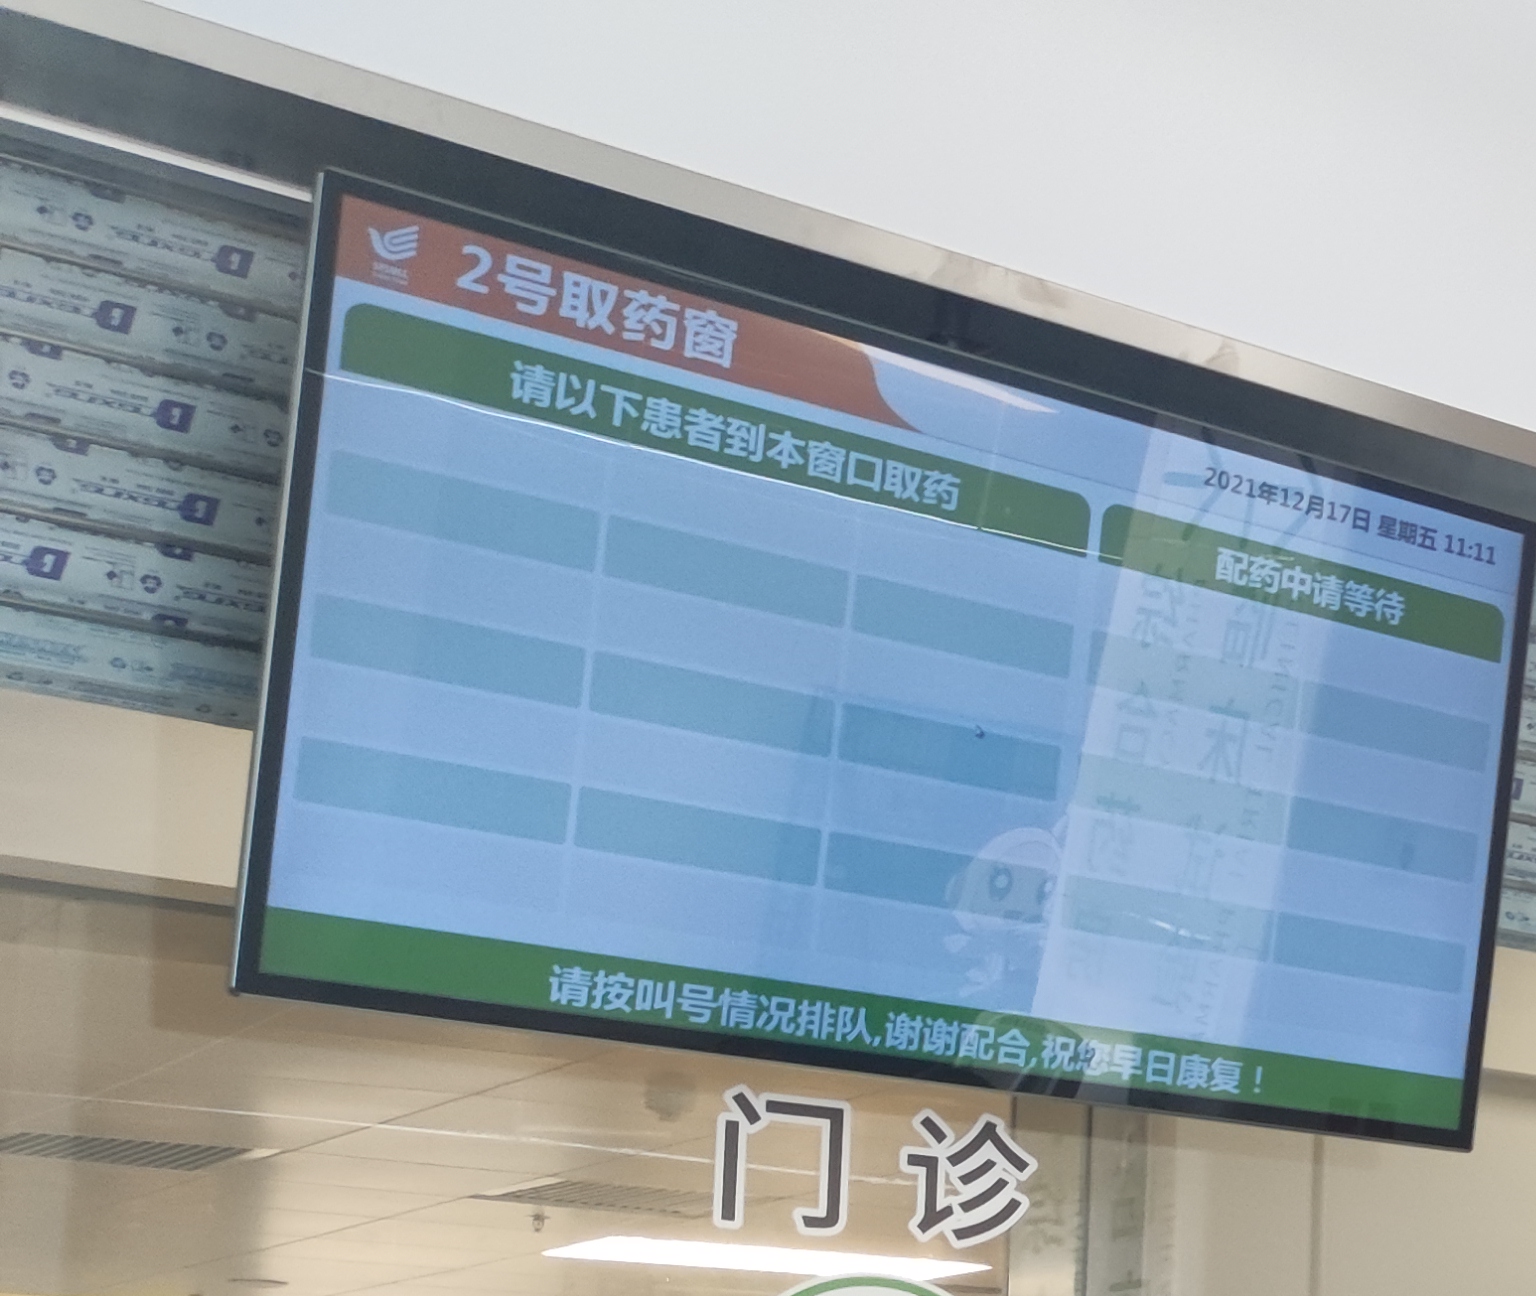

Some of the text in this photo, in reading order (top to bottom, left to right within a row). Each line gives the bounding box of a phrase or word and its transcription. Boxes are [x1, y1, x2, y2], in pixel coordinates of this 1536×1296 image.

[454, 243, 739, 369] 2号取药窗
[508, 359, 961, 513] 请以下患者到本窗口取药
[1203, 466, 1497, 566] 2021年12月17日 星期五 11:11
[1215, 546, 1407, 627] 配药中请等待
[716, 1090, 1034, 1244] 门诊
